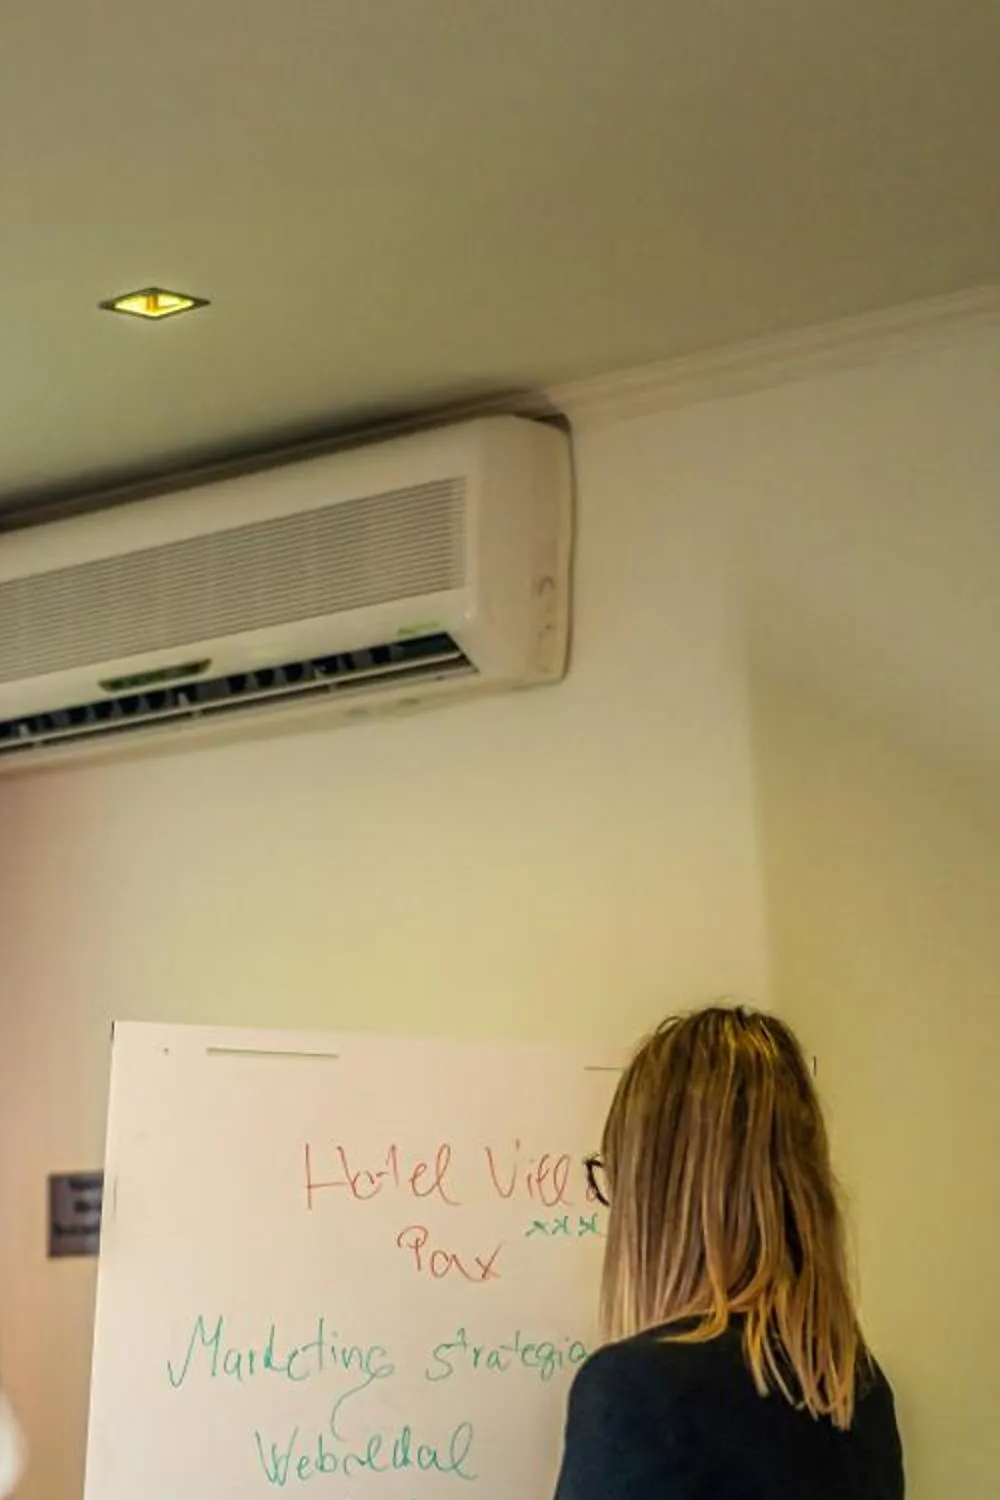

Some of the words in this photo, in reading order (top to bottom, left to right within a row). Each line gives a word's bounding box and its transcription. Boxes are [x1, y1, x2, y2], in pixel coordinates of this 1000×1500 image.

[303, 1143, 462, 1210] Hotel
[396, 1224, 504, 1283] Pax
[166, 1313, 396, 1442] Marketing
